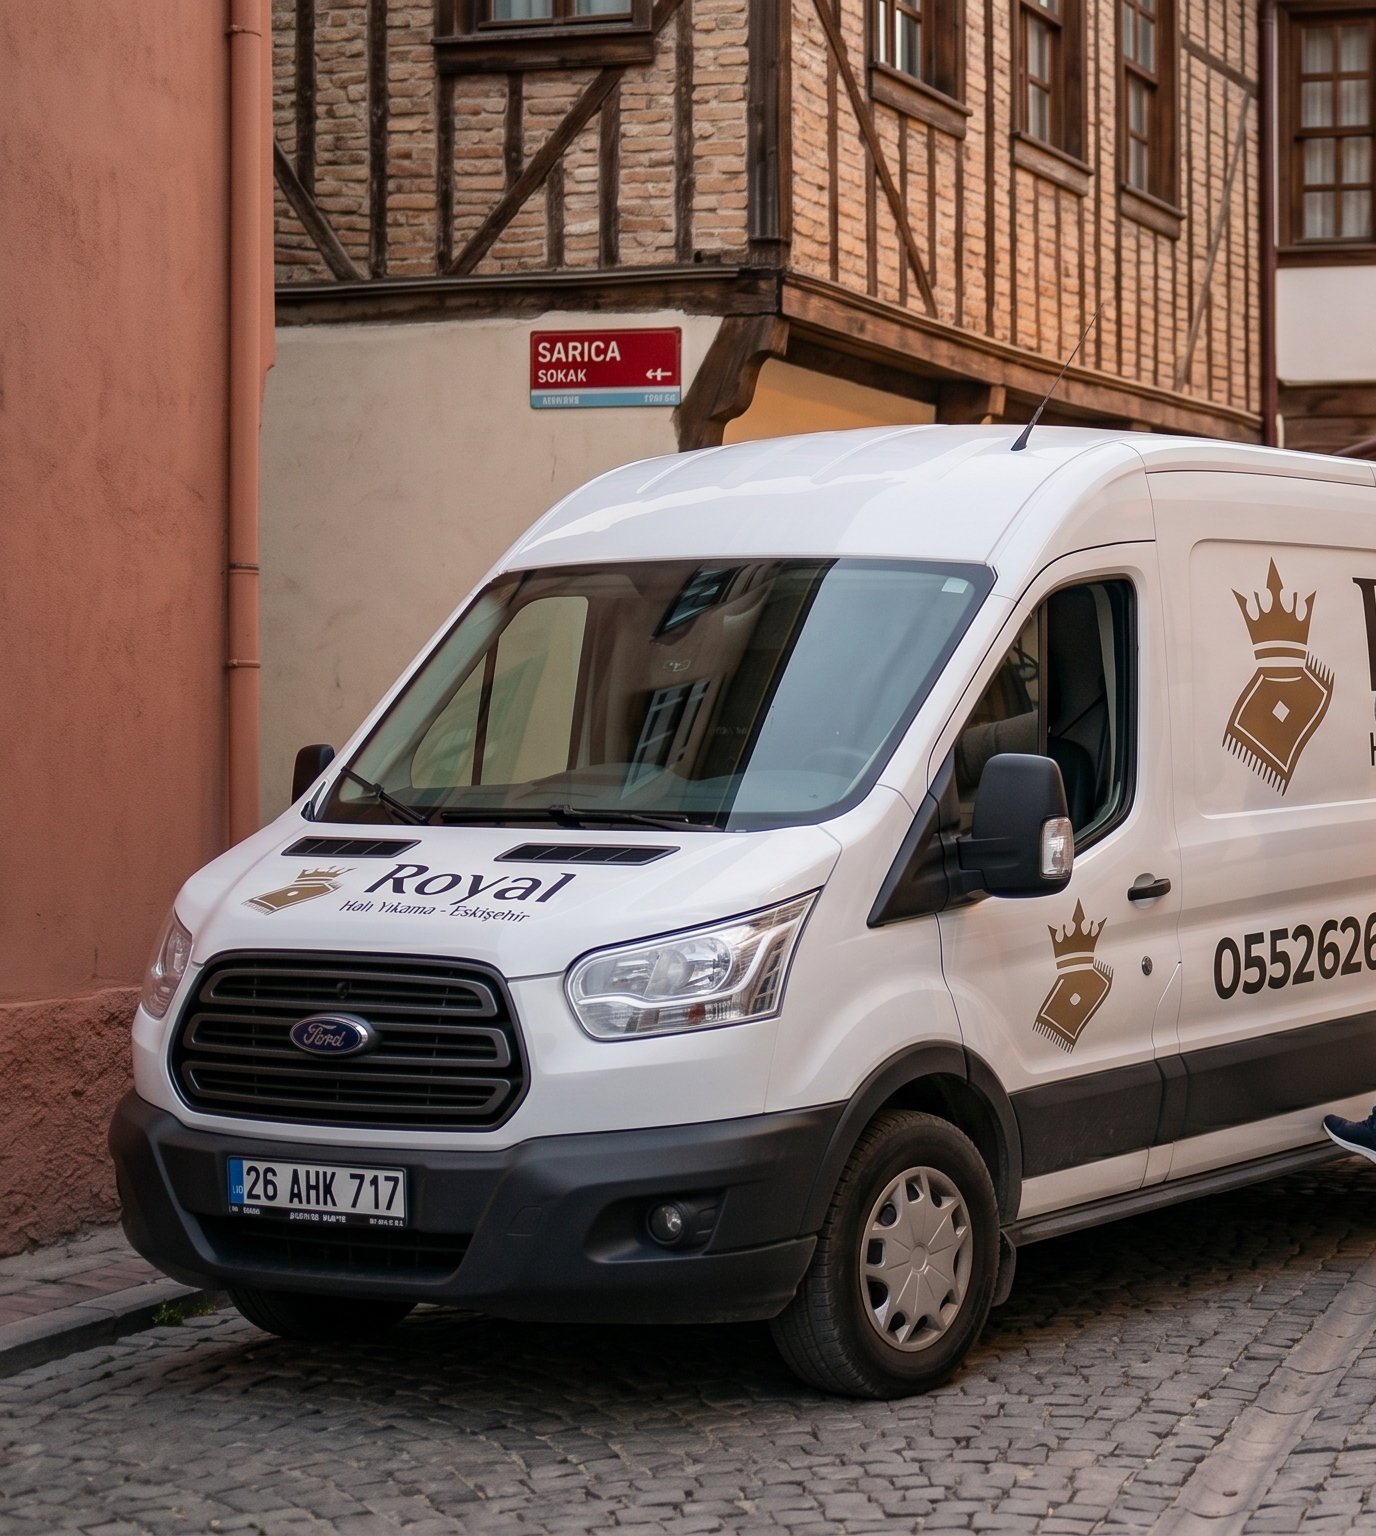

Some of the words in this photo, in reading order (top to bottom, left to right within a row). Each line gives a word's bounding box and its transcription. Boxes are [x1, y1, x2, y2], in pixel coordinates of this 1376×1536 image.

[538, 341, 621, 362] SARICA
[538, 369, 587, 383] SOKAK
[363, 863, 577, 905] Royal
[339, 900, 374, 912] Halı
[378, 901, 436, 915] Yıkama
[449, 905, 530, 922] Eskişehir
[303, 1022, 346, 1047] Ford
[246, 1165, 278, 1201] 26
[289, 1168, 337, 1207] AHK
[349, 1173, 400, 1211] 717
